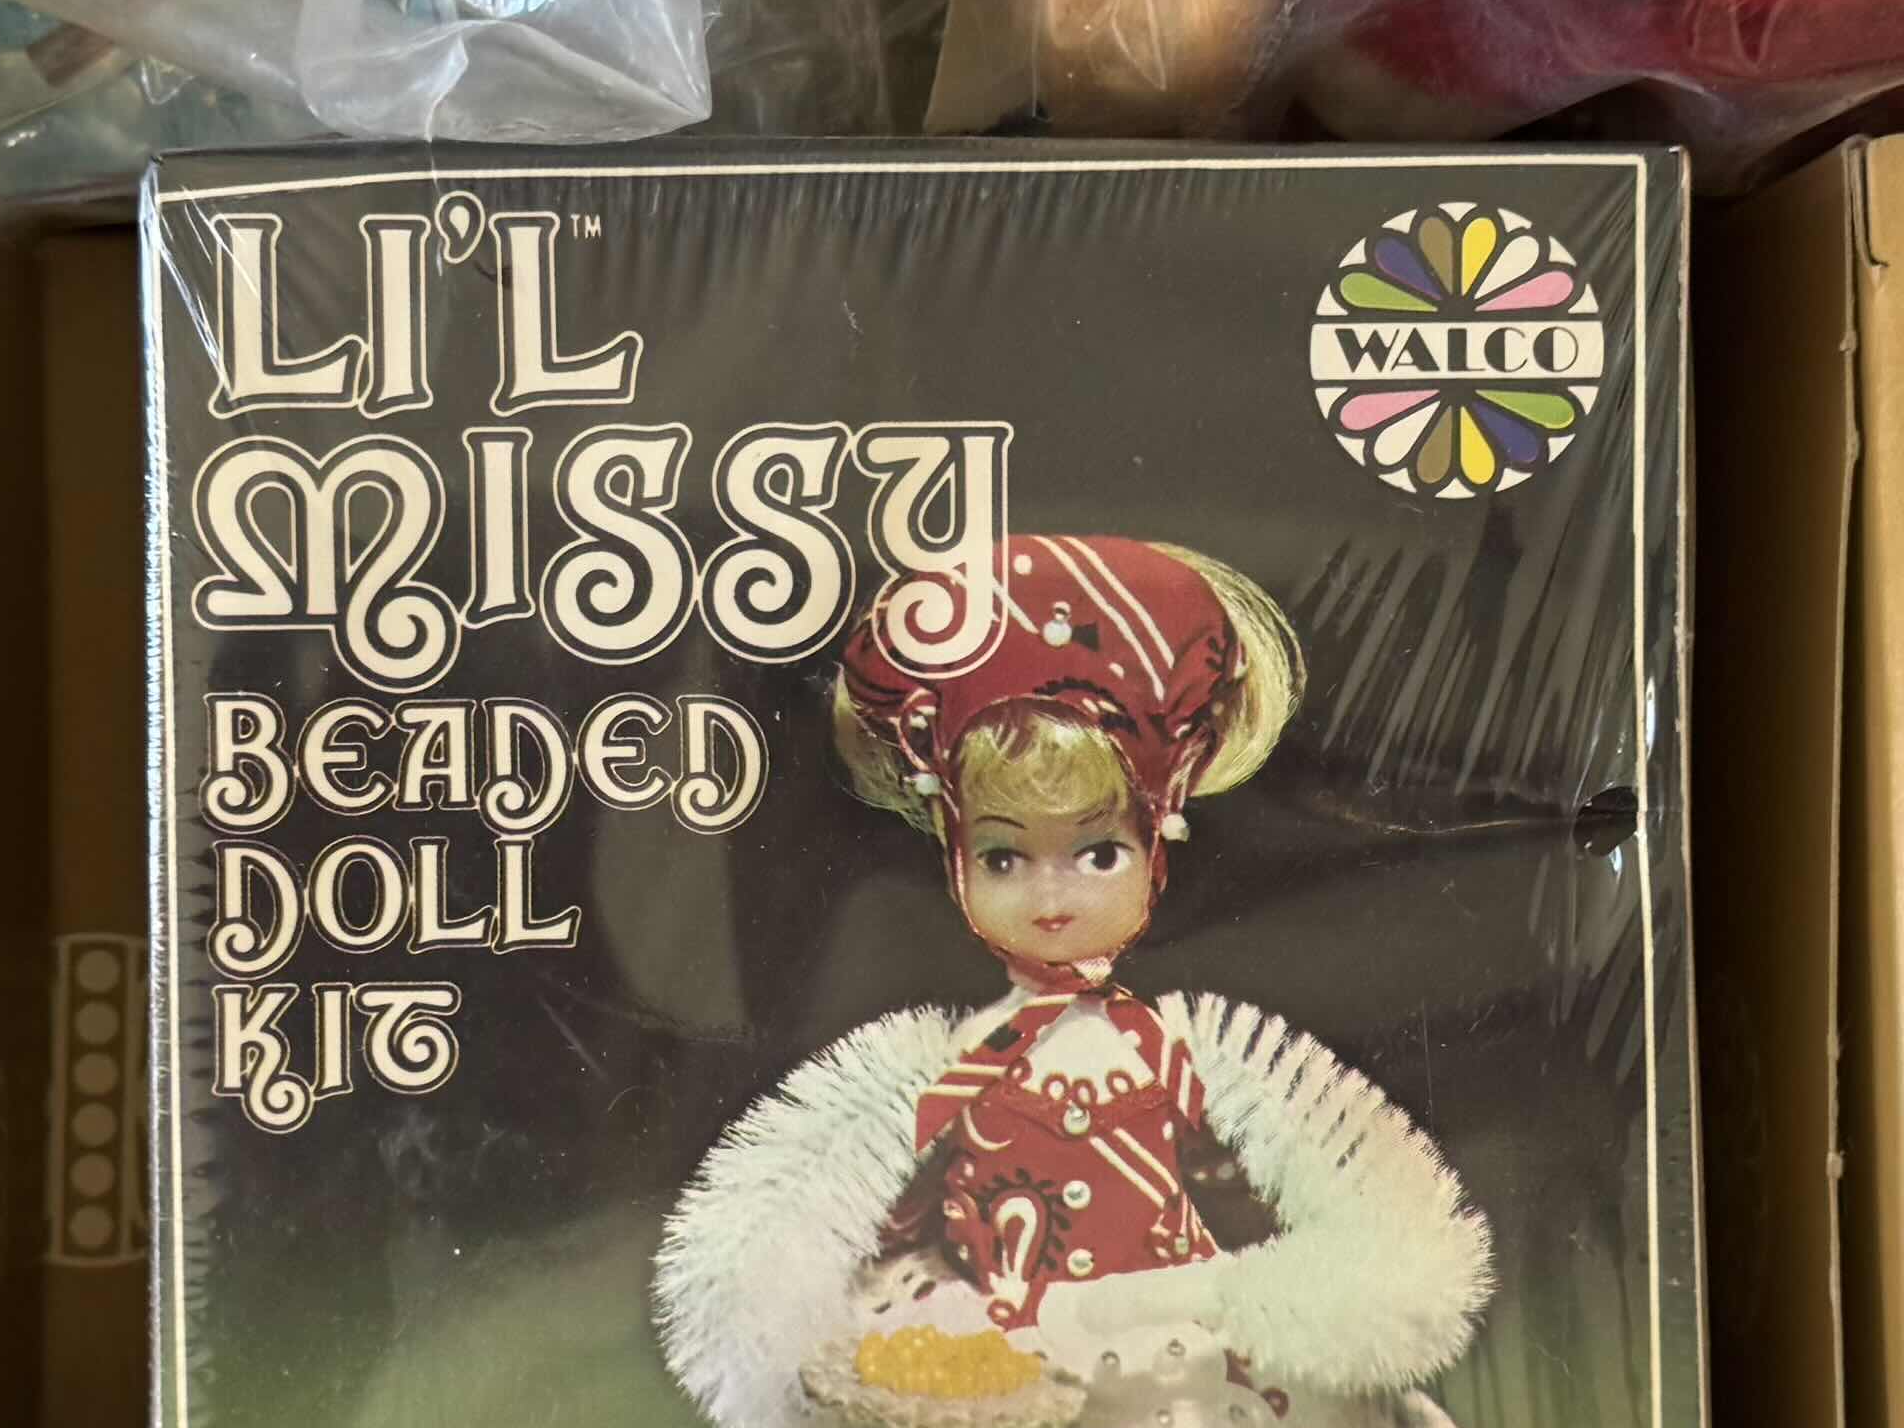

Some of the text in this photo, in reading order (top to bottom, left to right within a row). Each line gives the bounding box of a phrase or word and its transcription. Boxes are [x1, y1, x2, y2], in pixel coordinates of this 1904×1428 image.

[208, 190, 643, 418] LI'L
[1334, 326, 1579, 374] WALCO
[192, 421, 1014, 691] MISSY
[201, 692, 768, 834] BEADED
[207, 835, 581, 979] DOLL
[211, 982, 462, 1134] KIT
